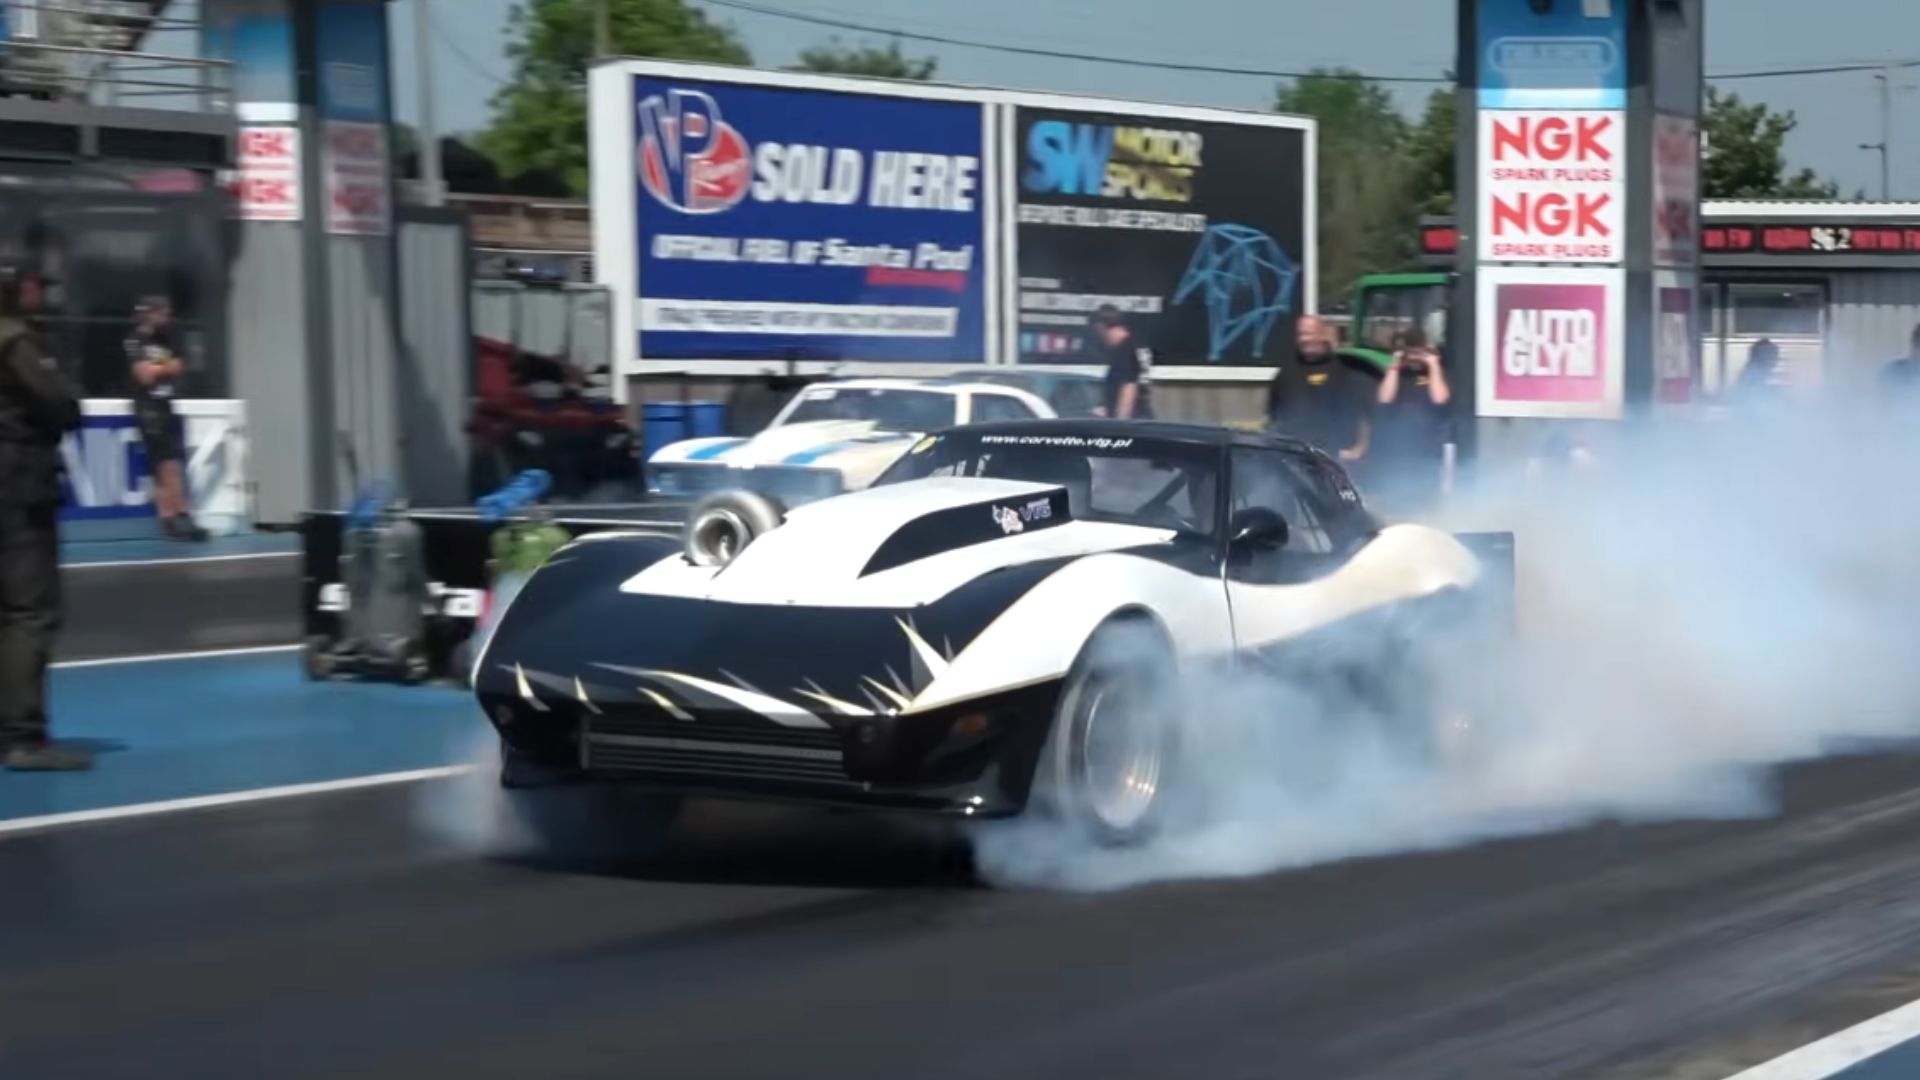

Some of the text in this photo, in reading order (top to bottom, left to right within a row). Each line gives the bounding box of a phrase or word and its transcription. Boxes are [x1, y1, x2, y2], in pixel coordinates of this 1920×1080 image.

[1023, 120, 1114, 195] SW
[1111, 126, 1204, 167] MOTOR
[1491, 116, 1613, 161] NGK
[751, 141, 864, 205] SOLD
[868, 150, 980, 212] HERE
[1492, 168, 1612, 182] SPARK PLUGS
[1491, 192, 1611, 237] NGK
[820, 238, 912, 269] Santa
[913, 242, 975, 271] Pod
[1492, 243, 1611, 258] SPARK PLUGS
[1504, 308, 1597, 344] AUTO
[1502, 340, 1597, 378] GLYM
